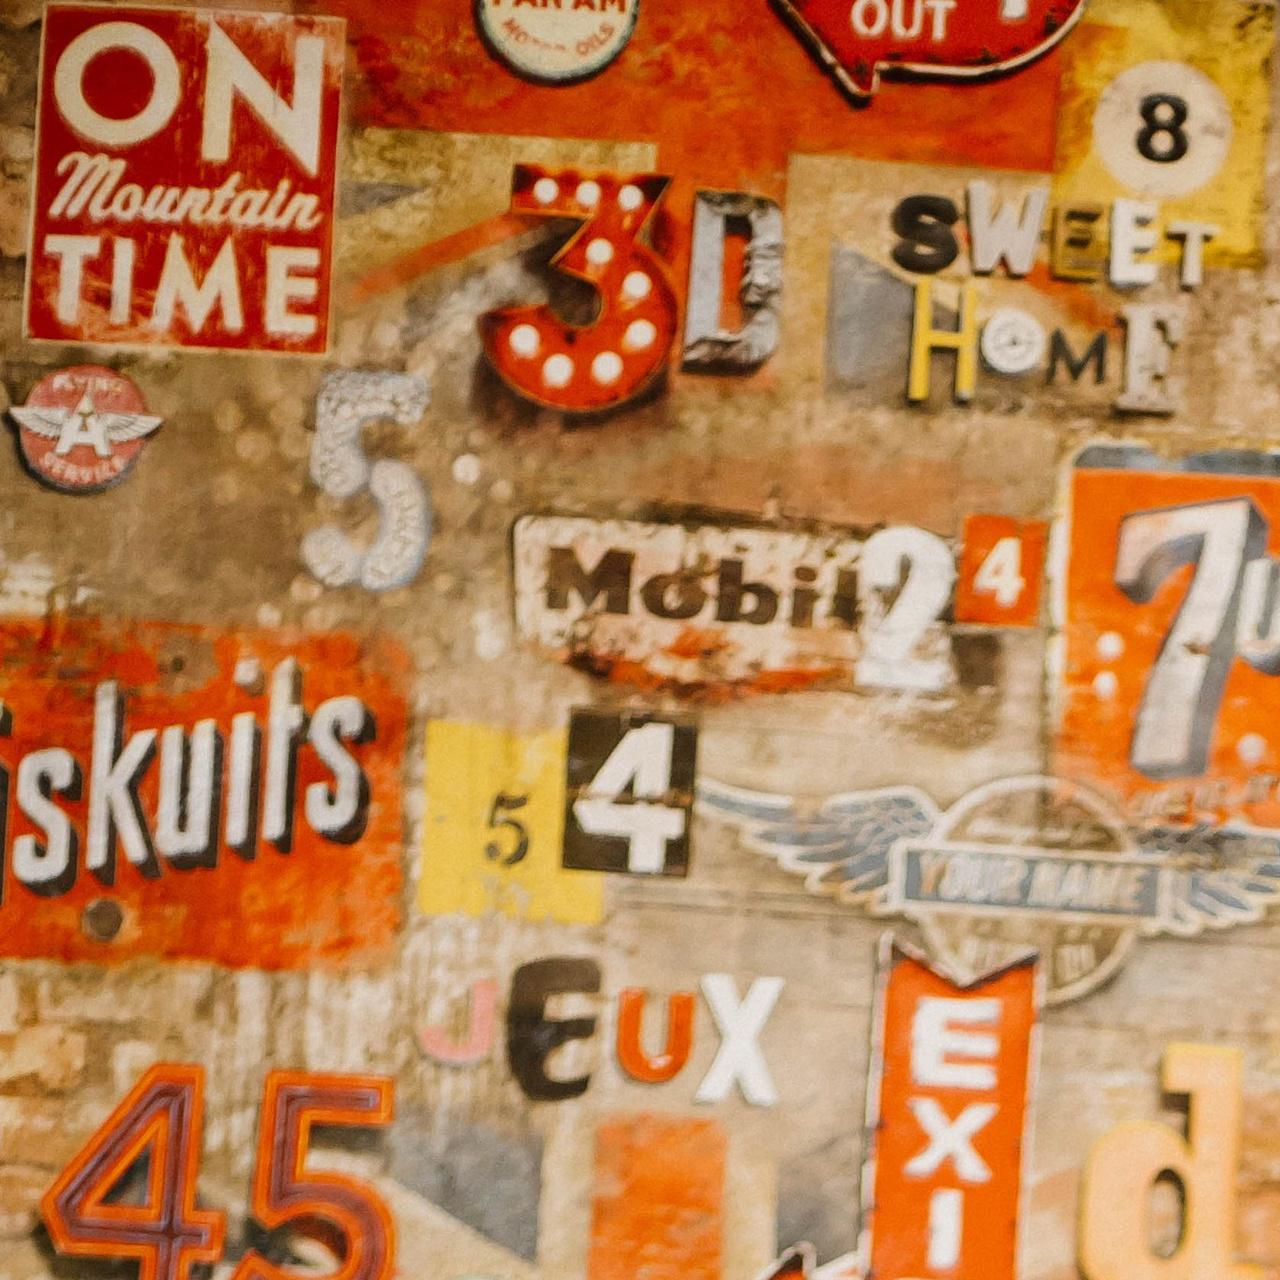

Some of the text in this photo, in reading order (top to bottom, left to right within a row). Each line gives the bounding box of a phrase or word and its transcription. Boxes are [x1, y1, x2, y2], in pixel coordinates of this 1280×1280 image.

[850, 0, 957, 41] OUT
[54, 21, 325, 178] ON
[1136, 92, 1189, 164] 8
[48, 150, 324, 230] Mountain
[890, 178, 1219, 289] SWEET
[44, 232, 320, 338] TIME
[906, 278, 1181, 413] HOME
[303, 370, 432, 590] 5
[543, 546, 858, 626] Mobil
[484, 722, 685, 875] 5 4
[418, 956, 785, 1106] JEUX
